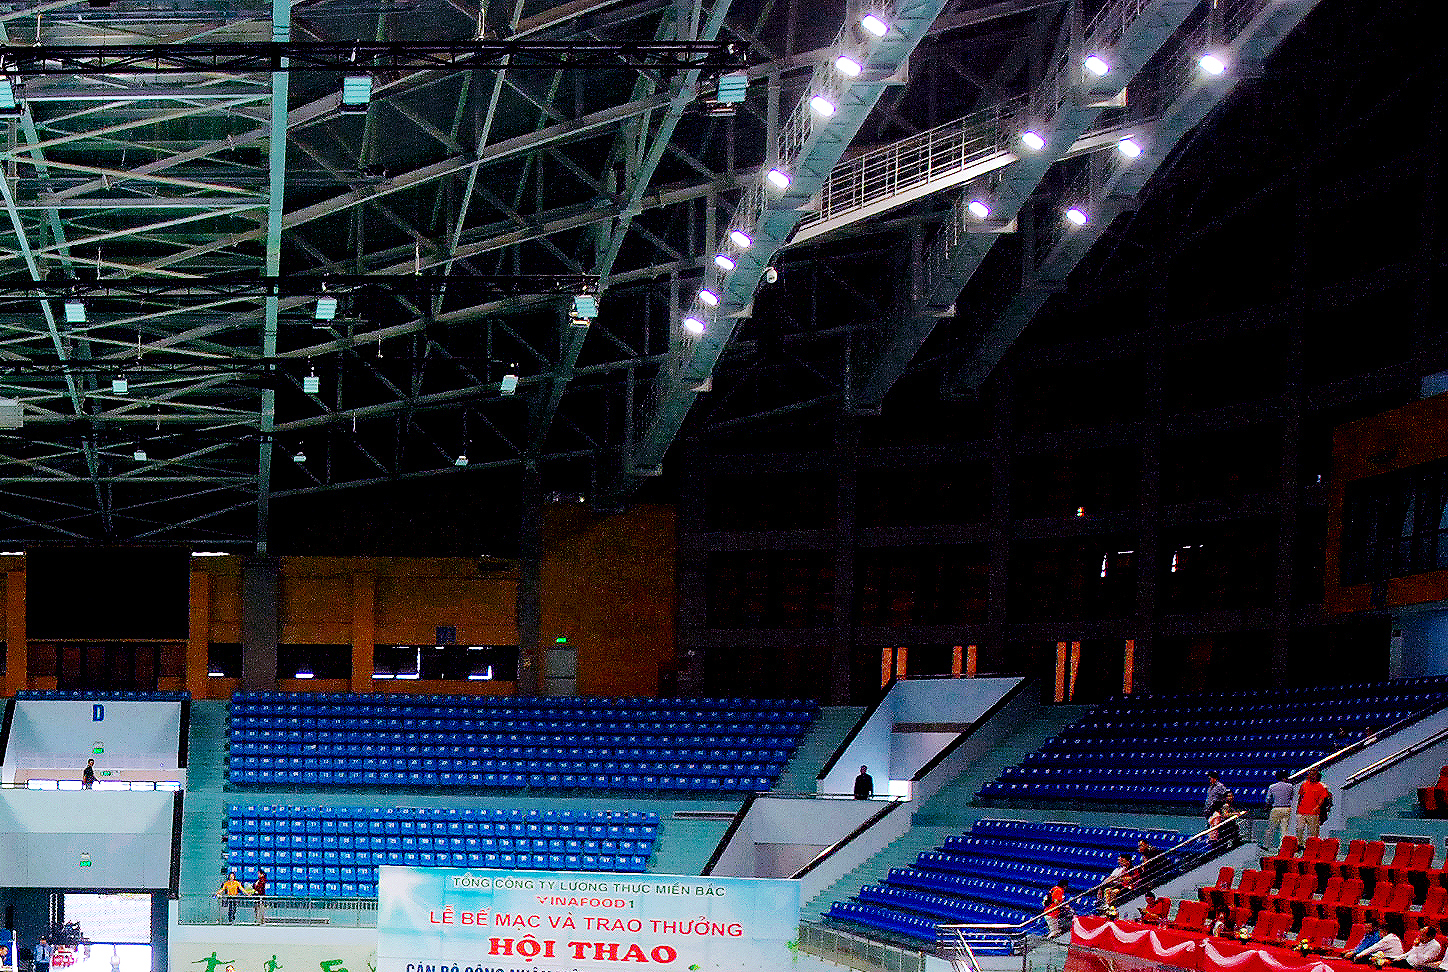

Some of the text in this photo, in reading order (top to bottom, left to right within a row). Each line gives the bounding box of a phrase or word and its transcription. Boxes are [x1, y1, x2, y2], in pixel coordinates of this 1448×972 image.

[92, 704, 104, 721] D
[494, 875, 534, 890] CÔNG
[539, 880, 556, 890] TY
[461, 908, 490, 926] BẾ
[495, 913, 540, 931] MẠC
[548, 912, 576, 930] VÀ
[583, 917, 643, 933] TRAO
[650, 915, 744, 938] THƯỞNG
[488, 933, 678, 965] HỘI THAO
